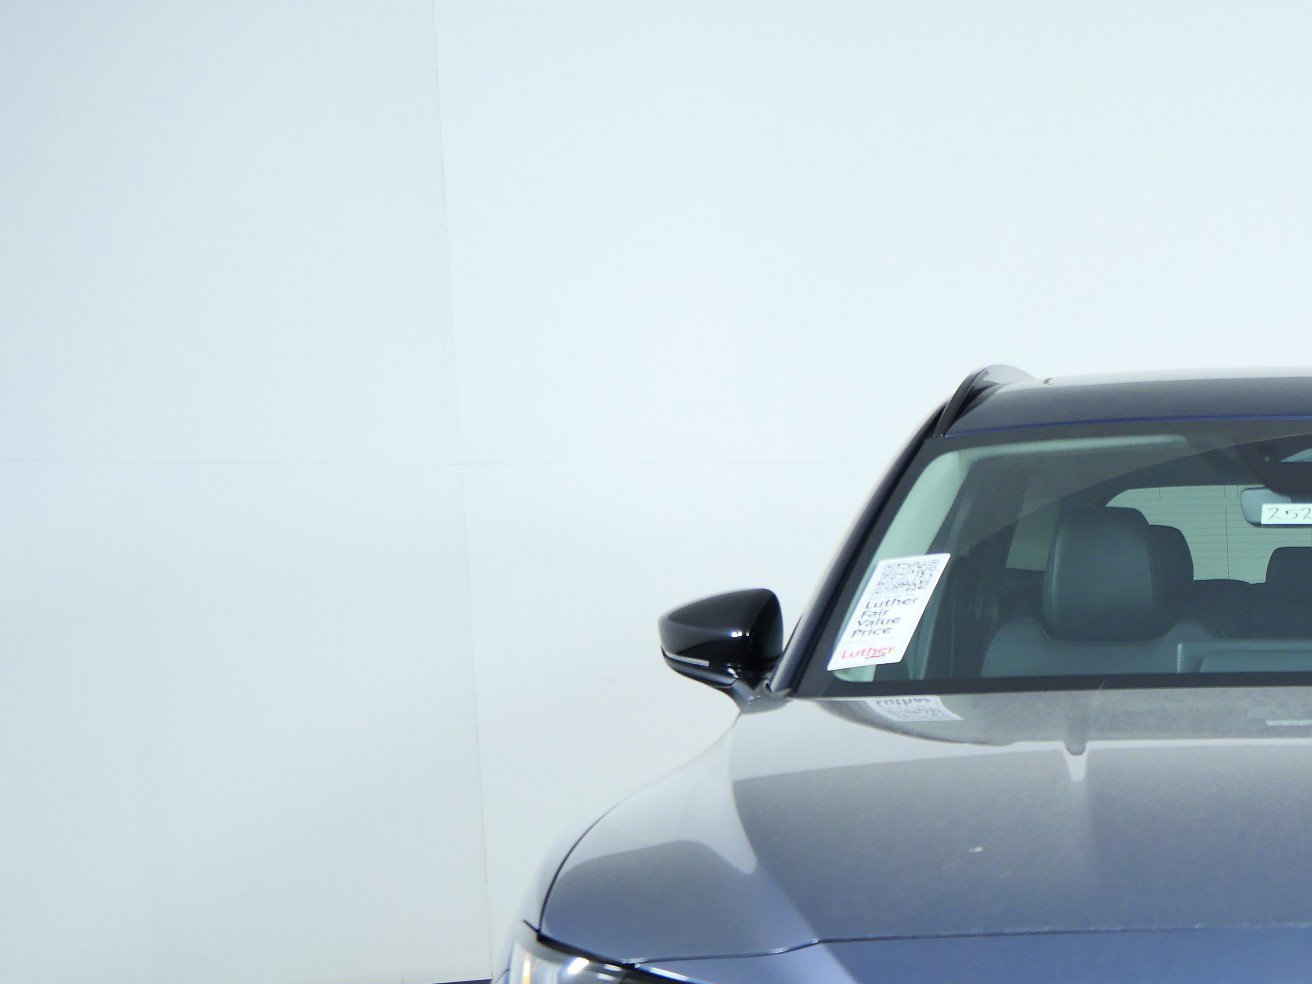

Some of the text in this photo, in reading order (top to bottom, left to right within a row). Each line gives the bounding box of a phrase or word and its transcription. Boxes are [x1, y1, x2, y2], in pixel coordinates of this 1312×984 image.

[866, 598, 919, 609] Luther
[861, 609, 890, 618] Fair
[857, 617, 901, 628] Value
[852, 627, 892, 637] Price
[841, 646, 896, 659] Luther
